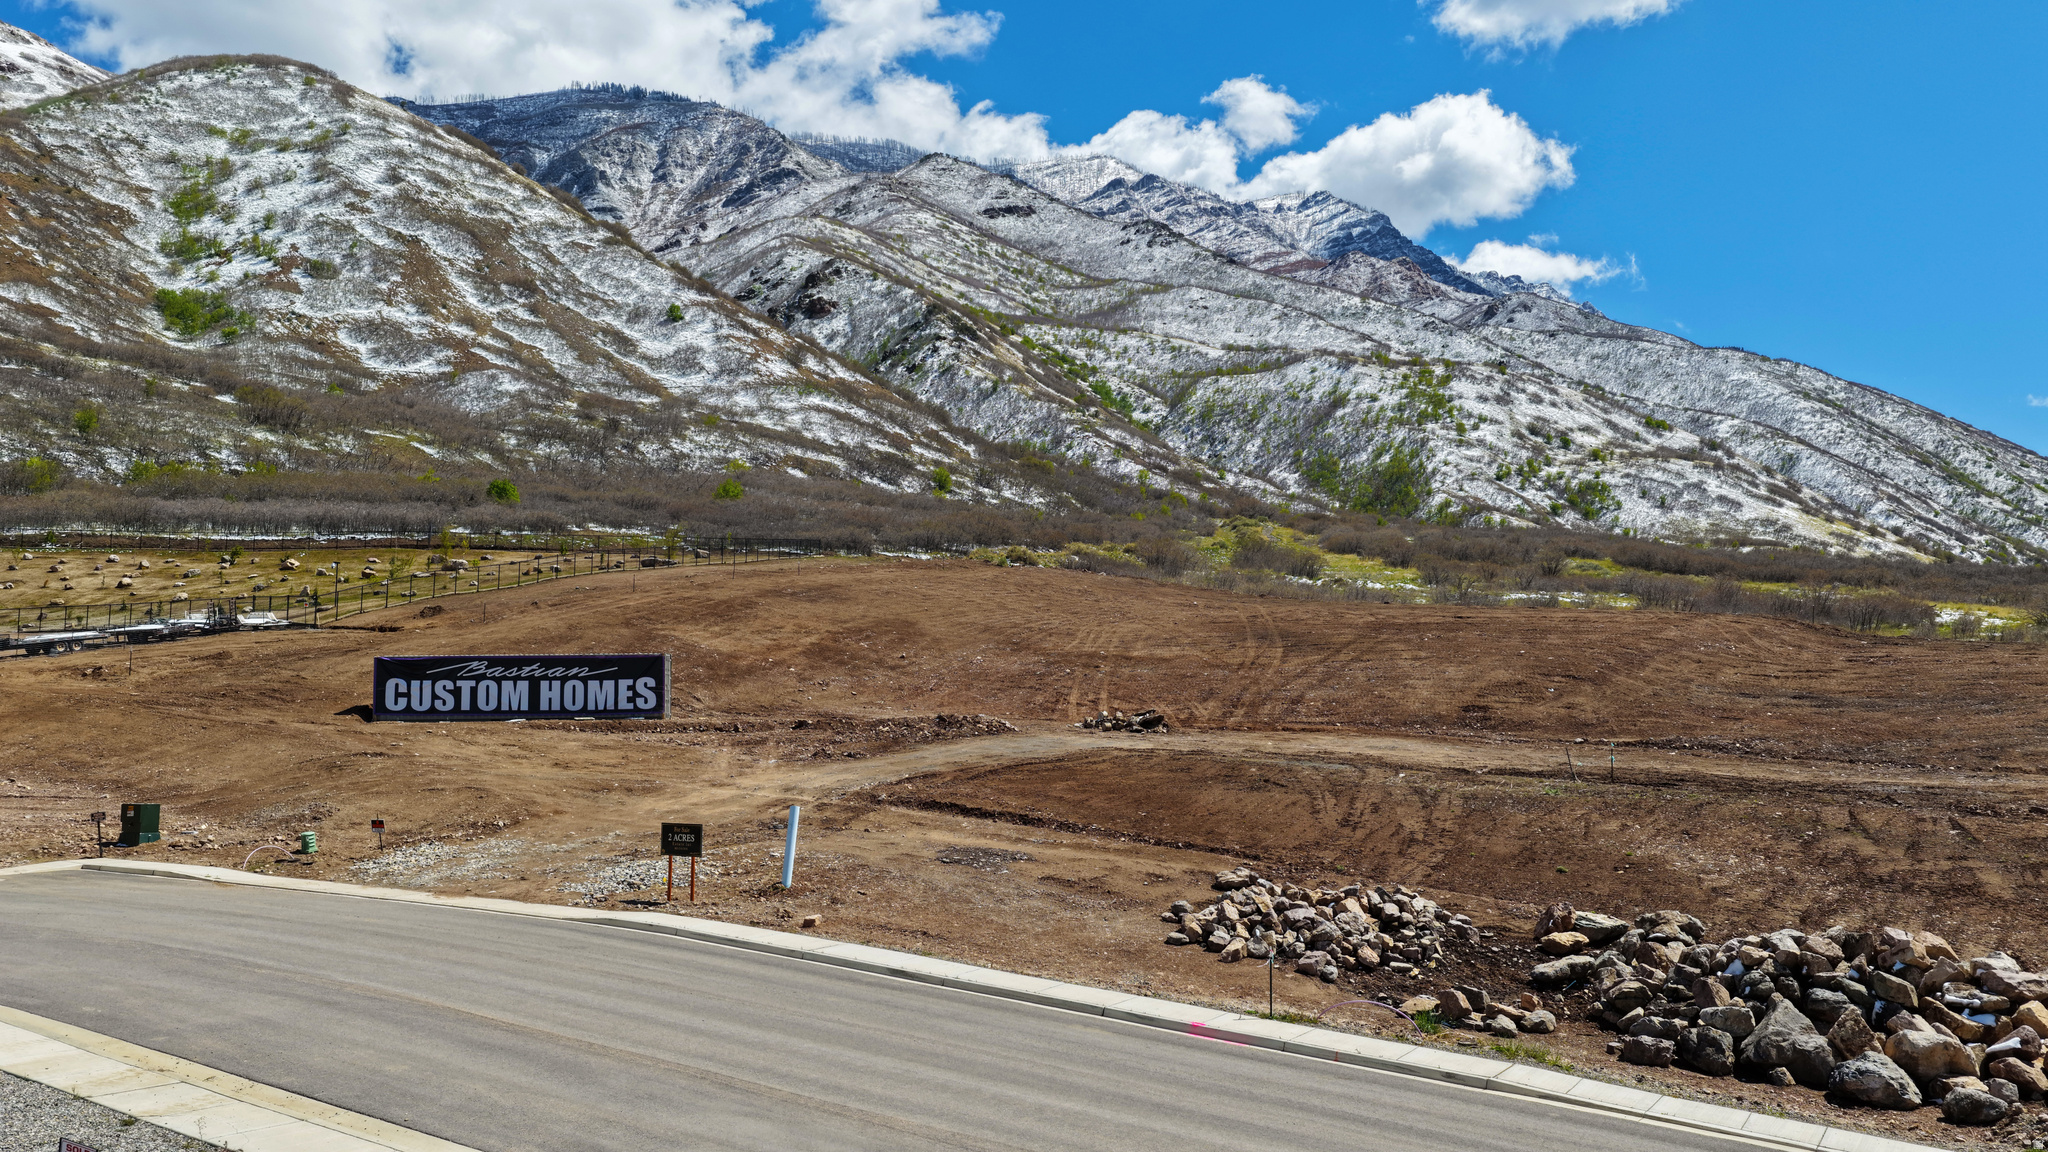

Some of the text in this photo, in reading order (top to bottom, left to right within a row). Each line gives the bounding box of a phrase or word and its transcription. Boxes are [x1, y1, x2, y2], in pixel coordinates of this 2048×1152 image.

[426, 660, 618, 677] Bastian
[385, 676, 657, 711] CUSTOM HOMES
[668, 833, 695, 842] 2 ACRES
[66, 1143, 91, 1152] SO
